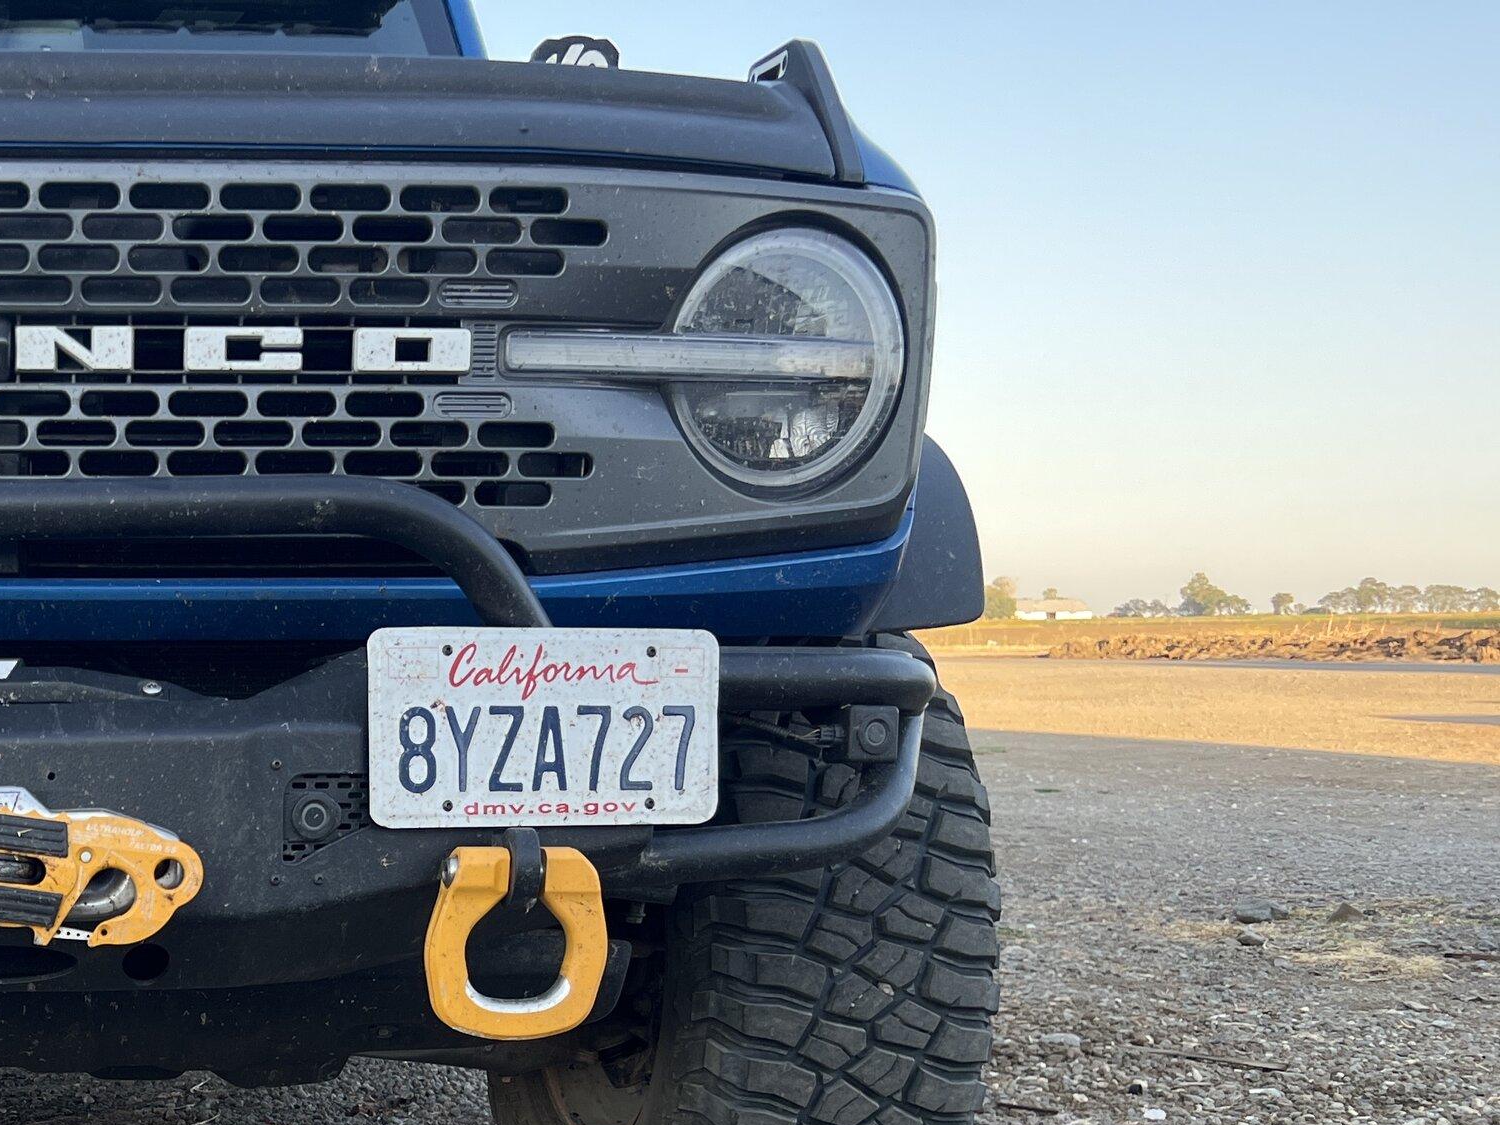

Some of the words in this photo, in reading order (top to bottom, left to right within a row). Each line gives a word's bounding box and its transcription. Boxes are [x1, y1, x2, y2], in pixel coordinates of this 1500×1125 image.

[448, 643, 660, 700] California
[399, 705, 696, 793] 8YZA727
[463, 800, 638, 817] dmv.ca.gov
